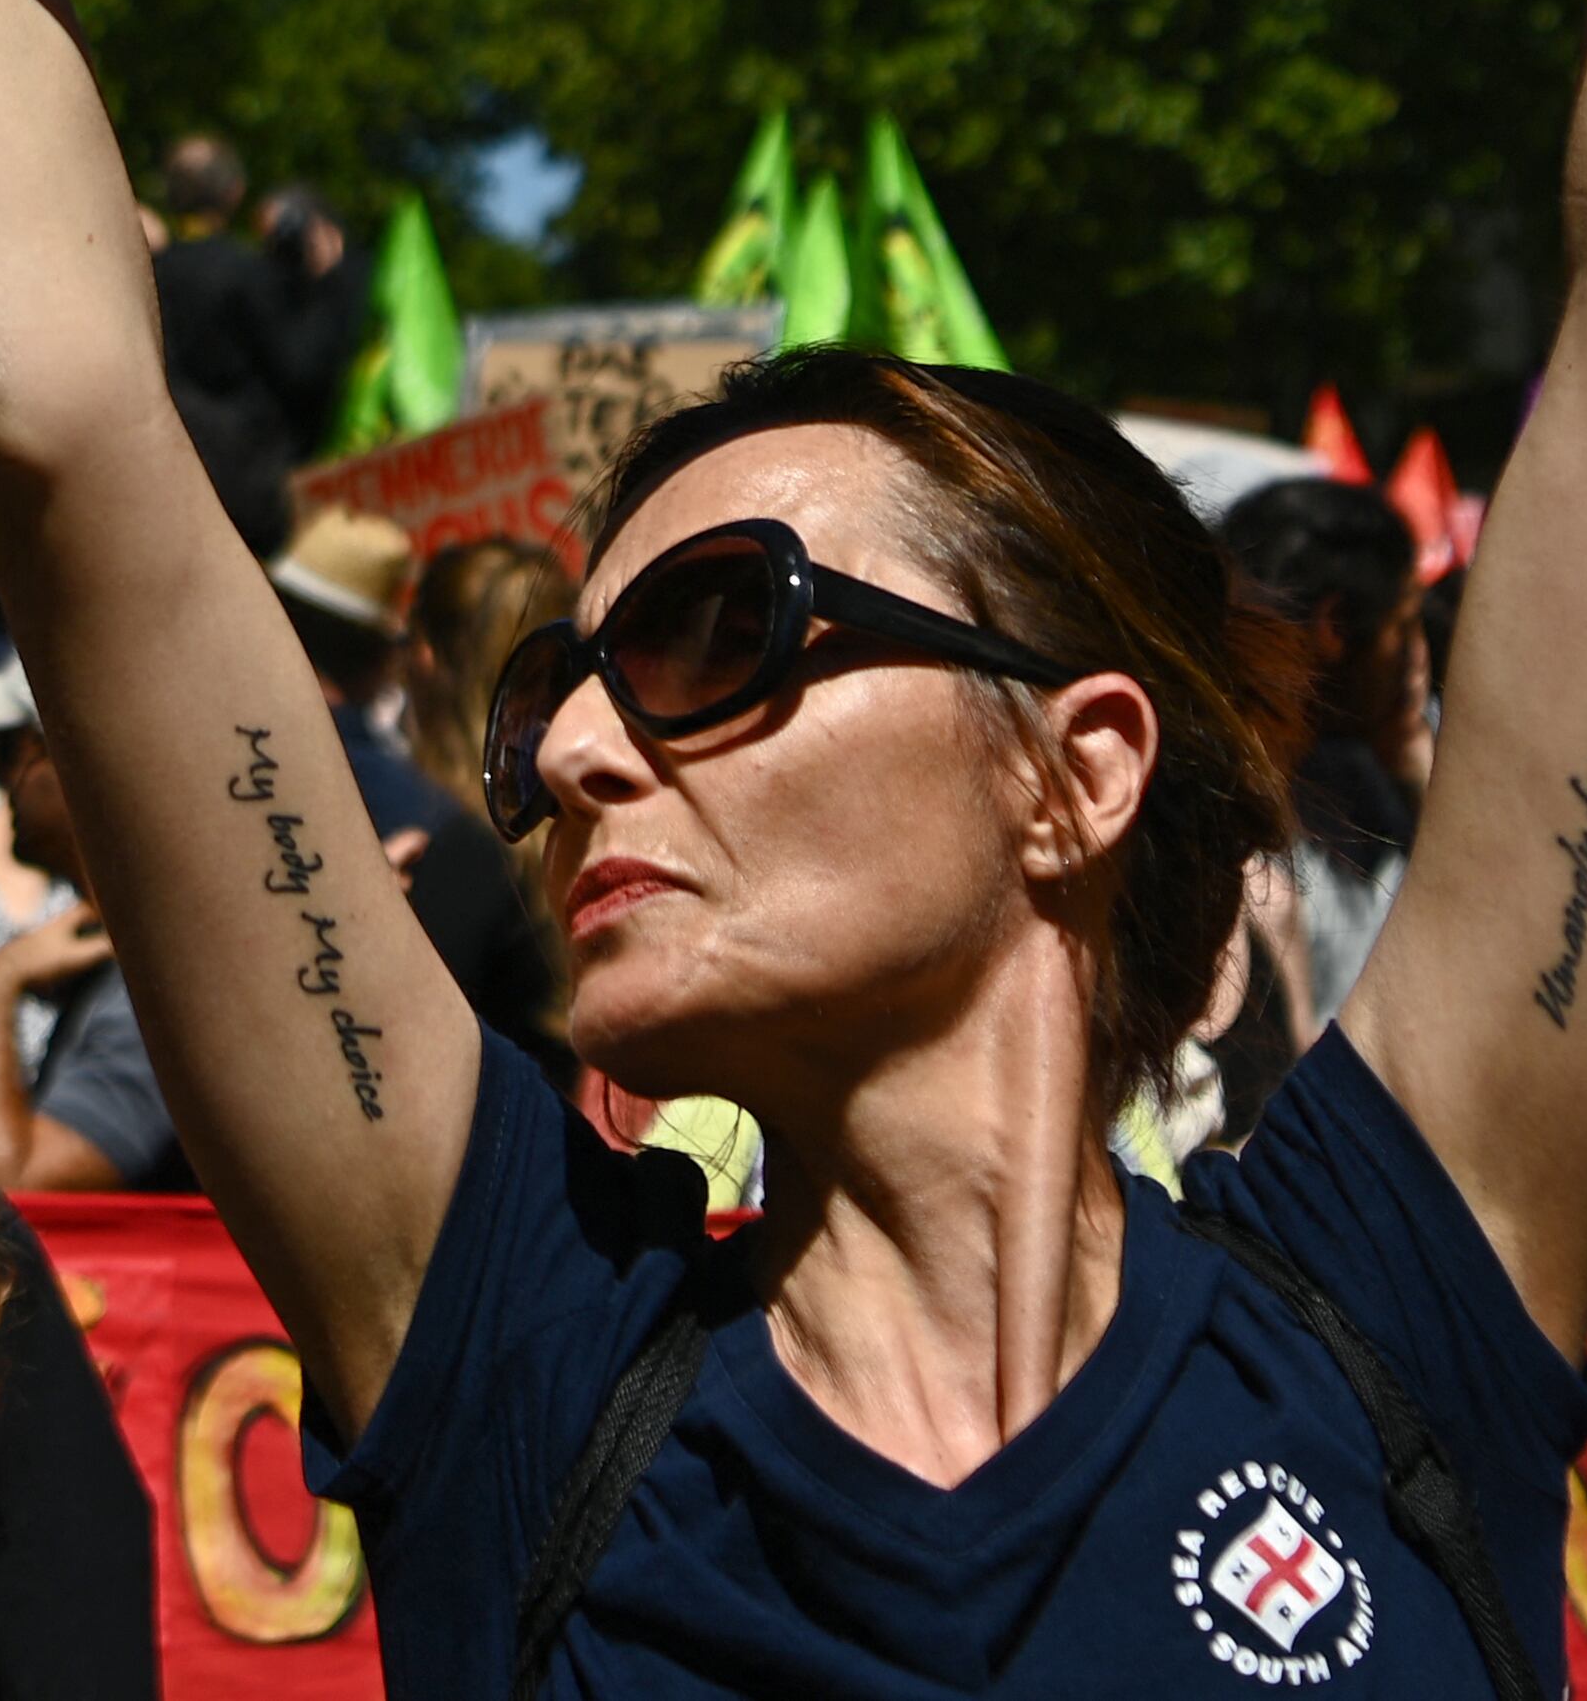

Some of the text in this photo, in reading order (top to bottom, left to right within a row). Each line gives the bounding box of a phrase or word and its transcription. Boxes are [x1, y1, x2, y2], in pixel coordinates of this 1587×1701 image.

[228, 724, 385, 1123] My body My choice
[1171, 1460, 1326, 1607] SEA RESCUE
[1208, 1631, 1332, 1686] SOUTH
